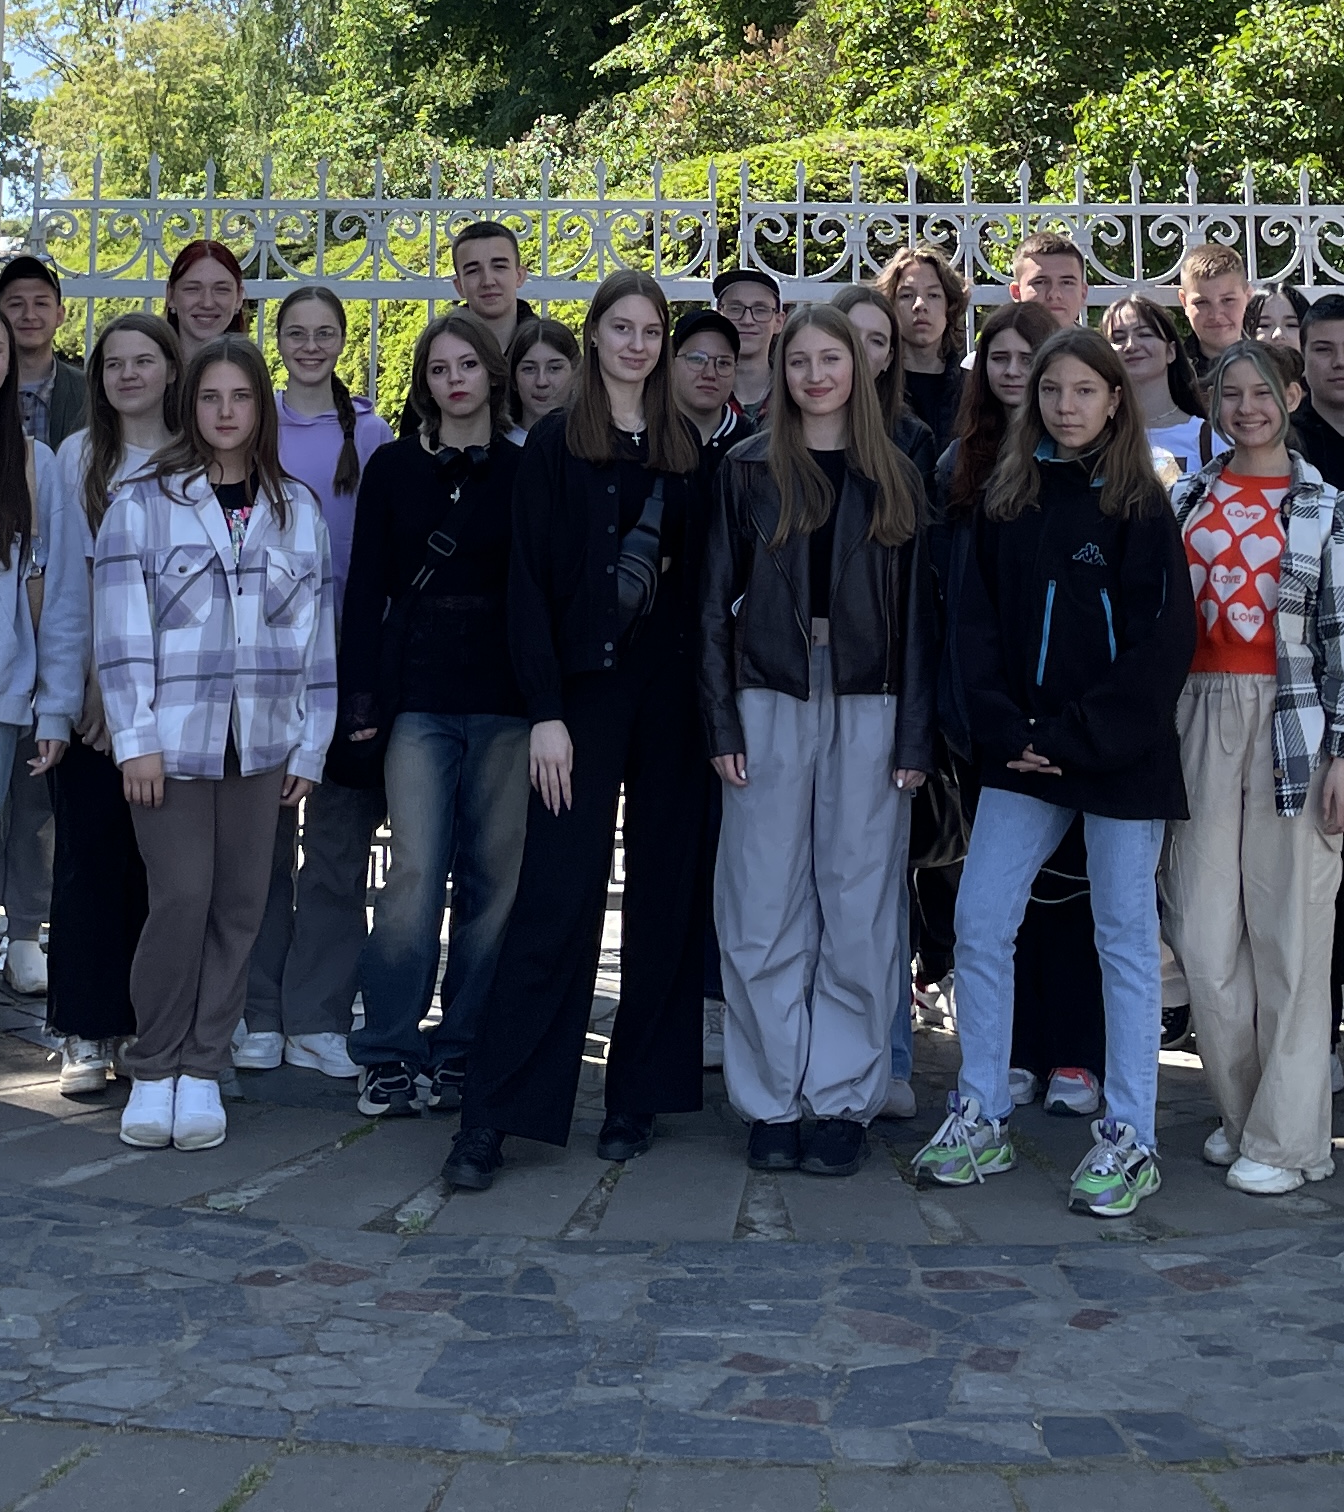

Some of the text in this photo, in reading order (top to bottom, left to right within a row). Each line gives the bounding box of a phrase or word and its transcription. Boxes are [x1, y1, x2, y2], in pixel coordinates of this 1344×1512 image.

[1226, 508, 1261, 520] LOVE
[1212, 572, 1241, 585] LOVE
[1231, 611, 1261, 624] LOVE
